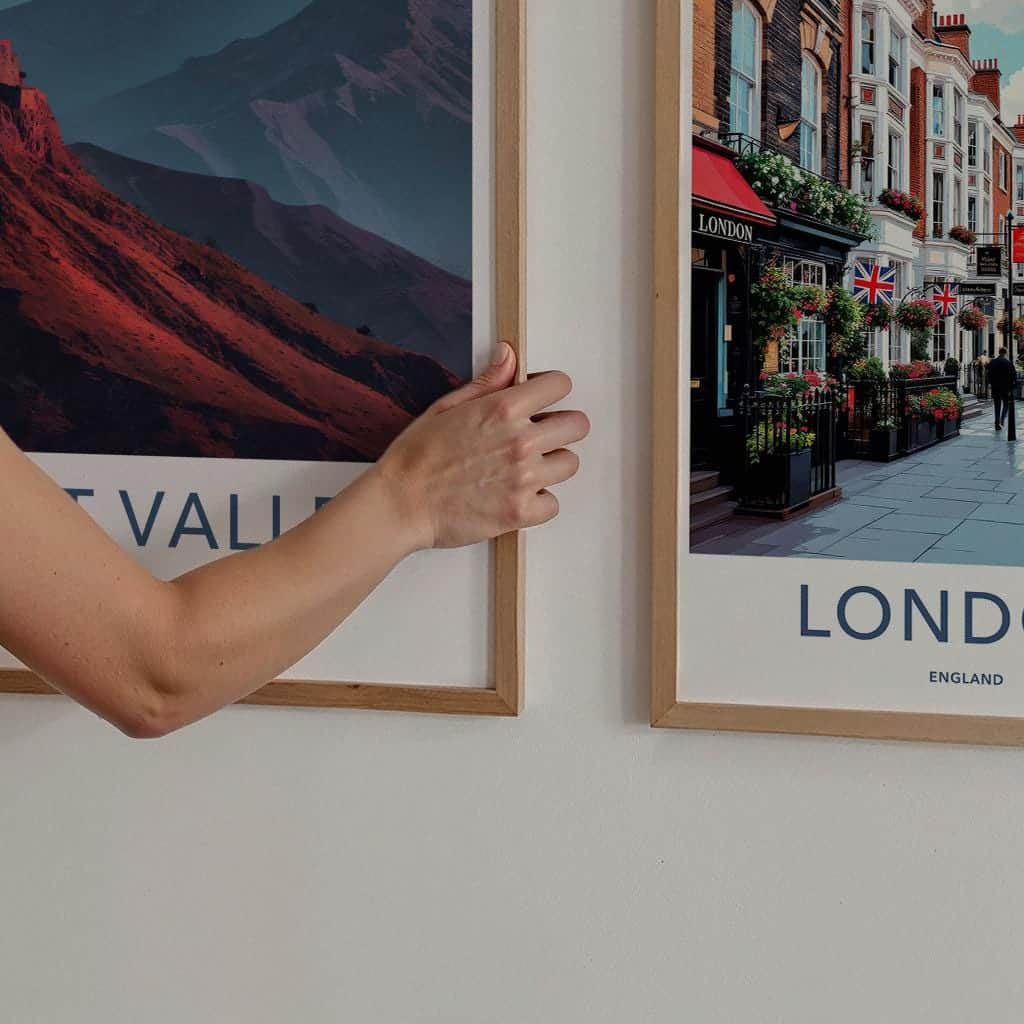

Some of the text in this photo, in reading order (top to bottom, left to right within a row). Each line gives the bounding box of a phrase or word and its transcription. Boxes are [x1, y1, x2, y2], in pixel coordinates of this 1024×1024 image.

[699, 213, 753, 242] LONDON
[800, 584, 1024, 645] LOND
[929, 670, 1004, 686] ENGLAND
